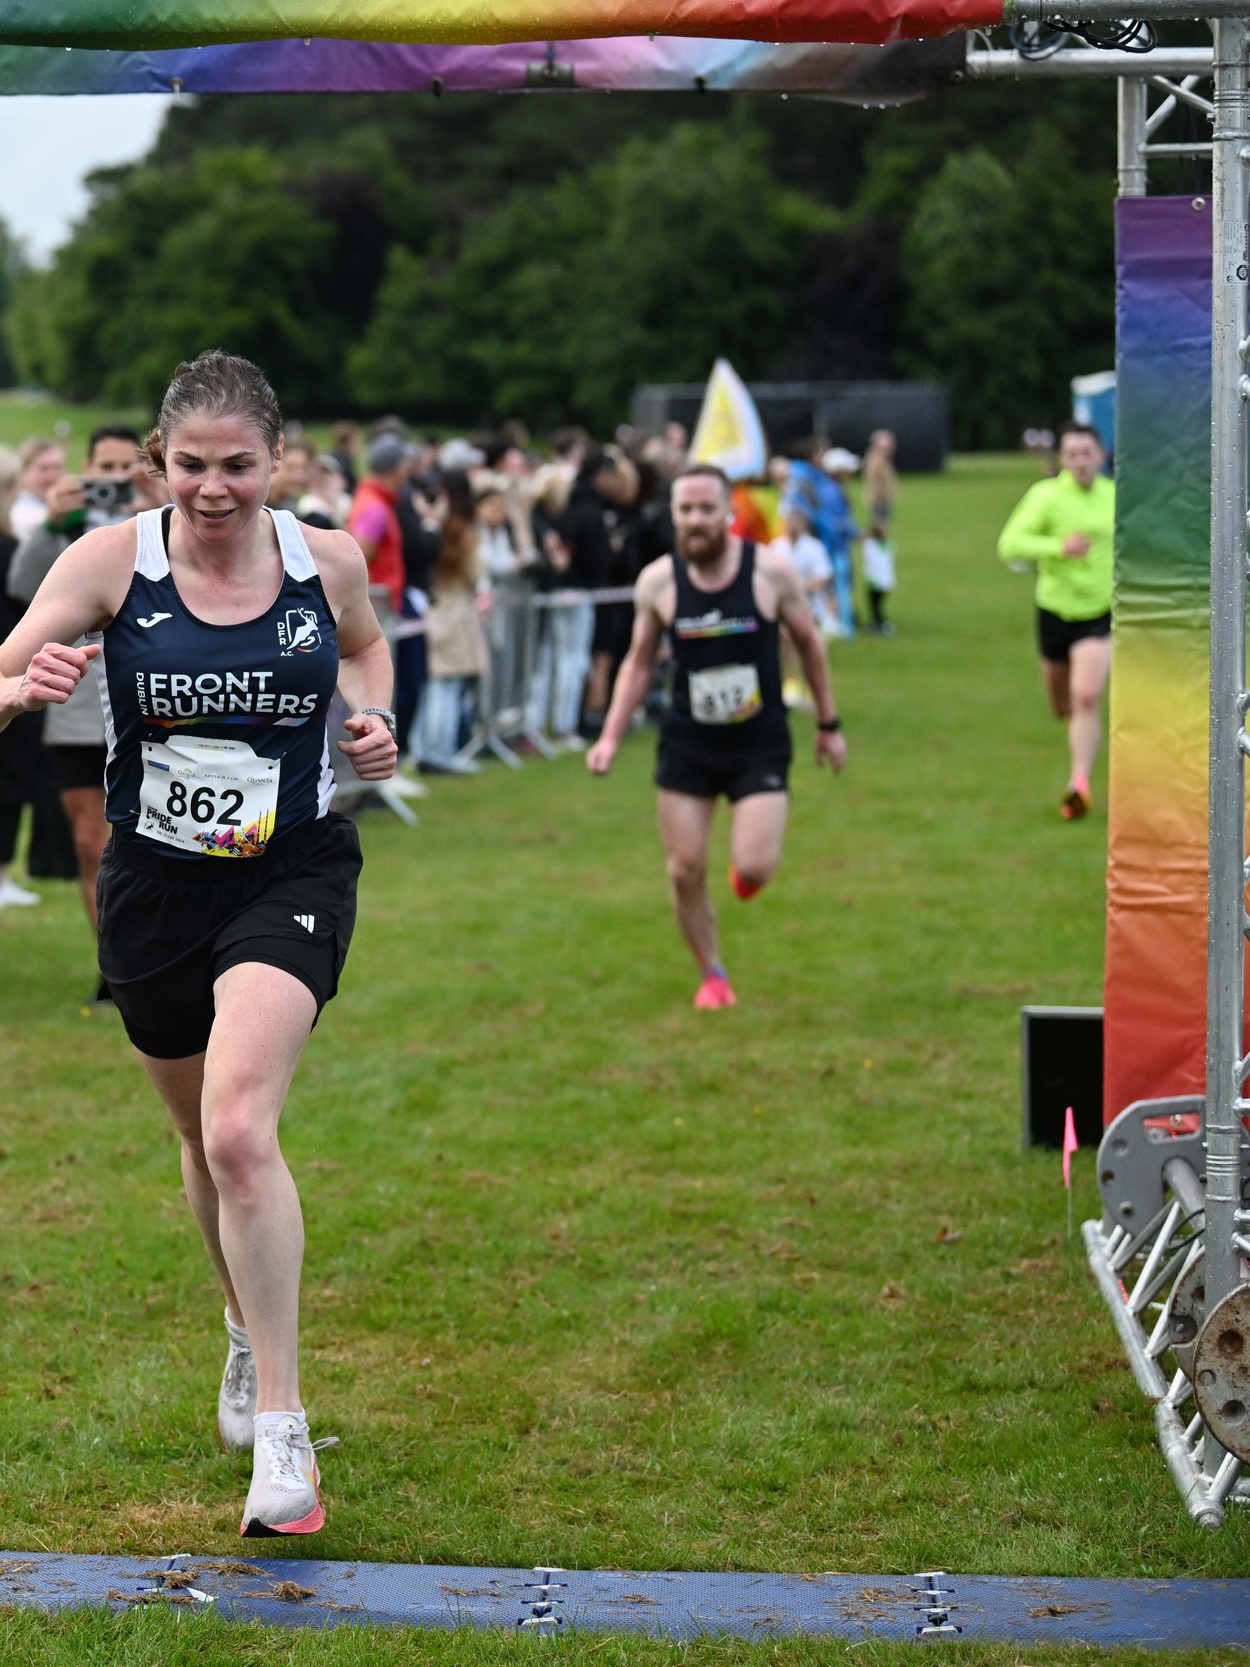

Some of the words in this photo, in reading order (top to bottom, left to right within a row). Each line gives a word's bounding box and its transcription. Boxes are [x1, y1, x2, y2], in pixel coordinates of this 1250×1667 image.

[276, 621, 287, 646] DFR
[135, 671, 149, 716] DUBLIN
[149, 671, 274, 697] FRONT
[151, 693, 319, 718] RUNNERS
[246, 776, 273, 784] QUANTA
[166, 780, 244, 826] 862
[146, 808, 172, 825] PRIDE
[158, 821, 178, 835] RUN
